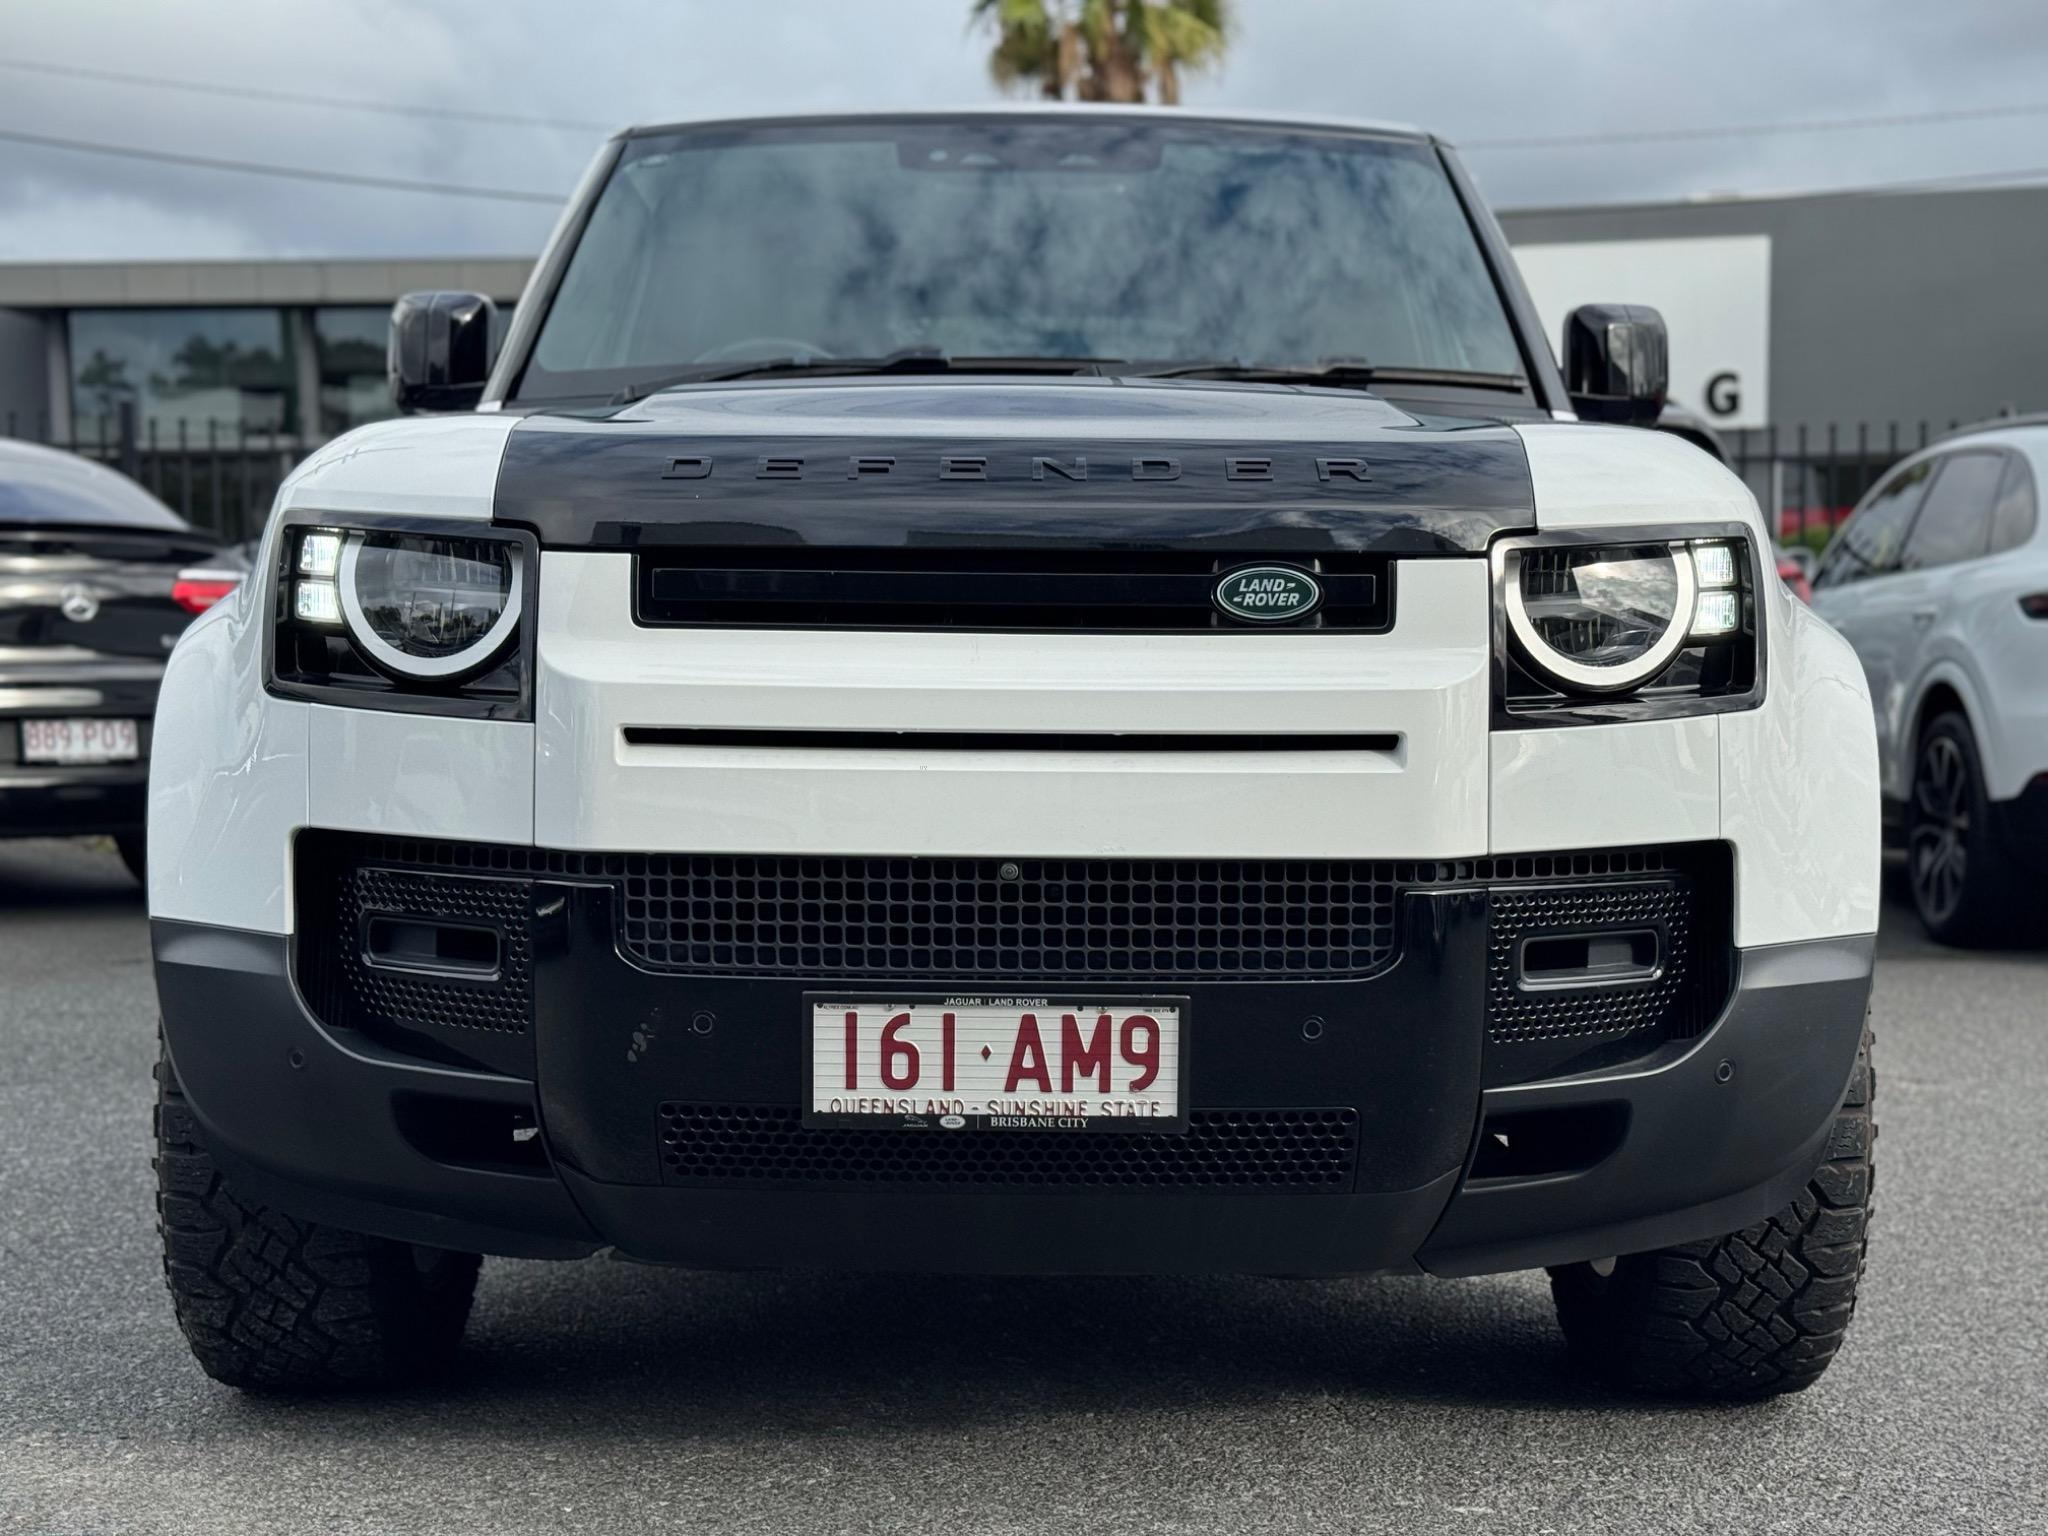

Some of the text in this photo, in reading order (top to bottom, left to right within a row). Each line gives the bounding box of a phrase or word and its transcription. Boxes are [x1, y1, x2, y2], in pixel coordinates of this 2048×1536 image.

[1706, 372, 1738, 416] G
[661, 456, 1373, 482] DEFENDER
[1239, 579, 1285, 592] LAND
[1243, 593, 1300, 606] ROVER
[944, 998, 1048, 1007] JAGUAR LAND ROVER
[830, 1098, 964, 1115] QUEENSLAND
[986, 1099, 1088, 1116] SUNSHINE
[1101, 1100, 1161, 1117] STATE
[990, 1117, 1089, 1129] BRISBANE CITY
